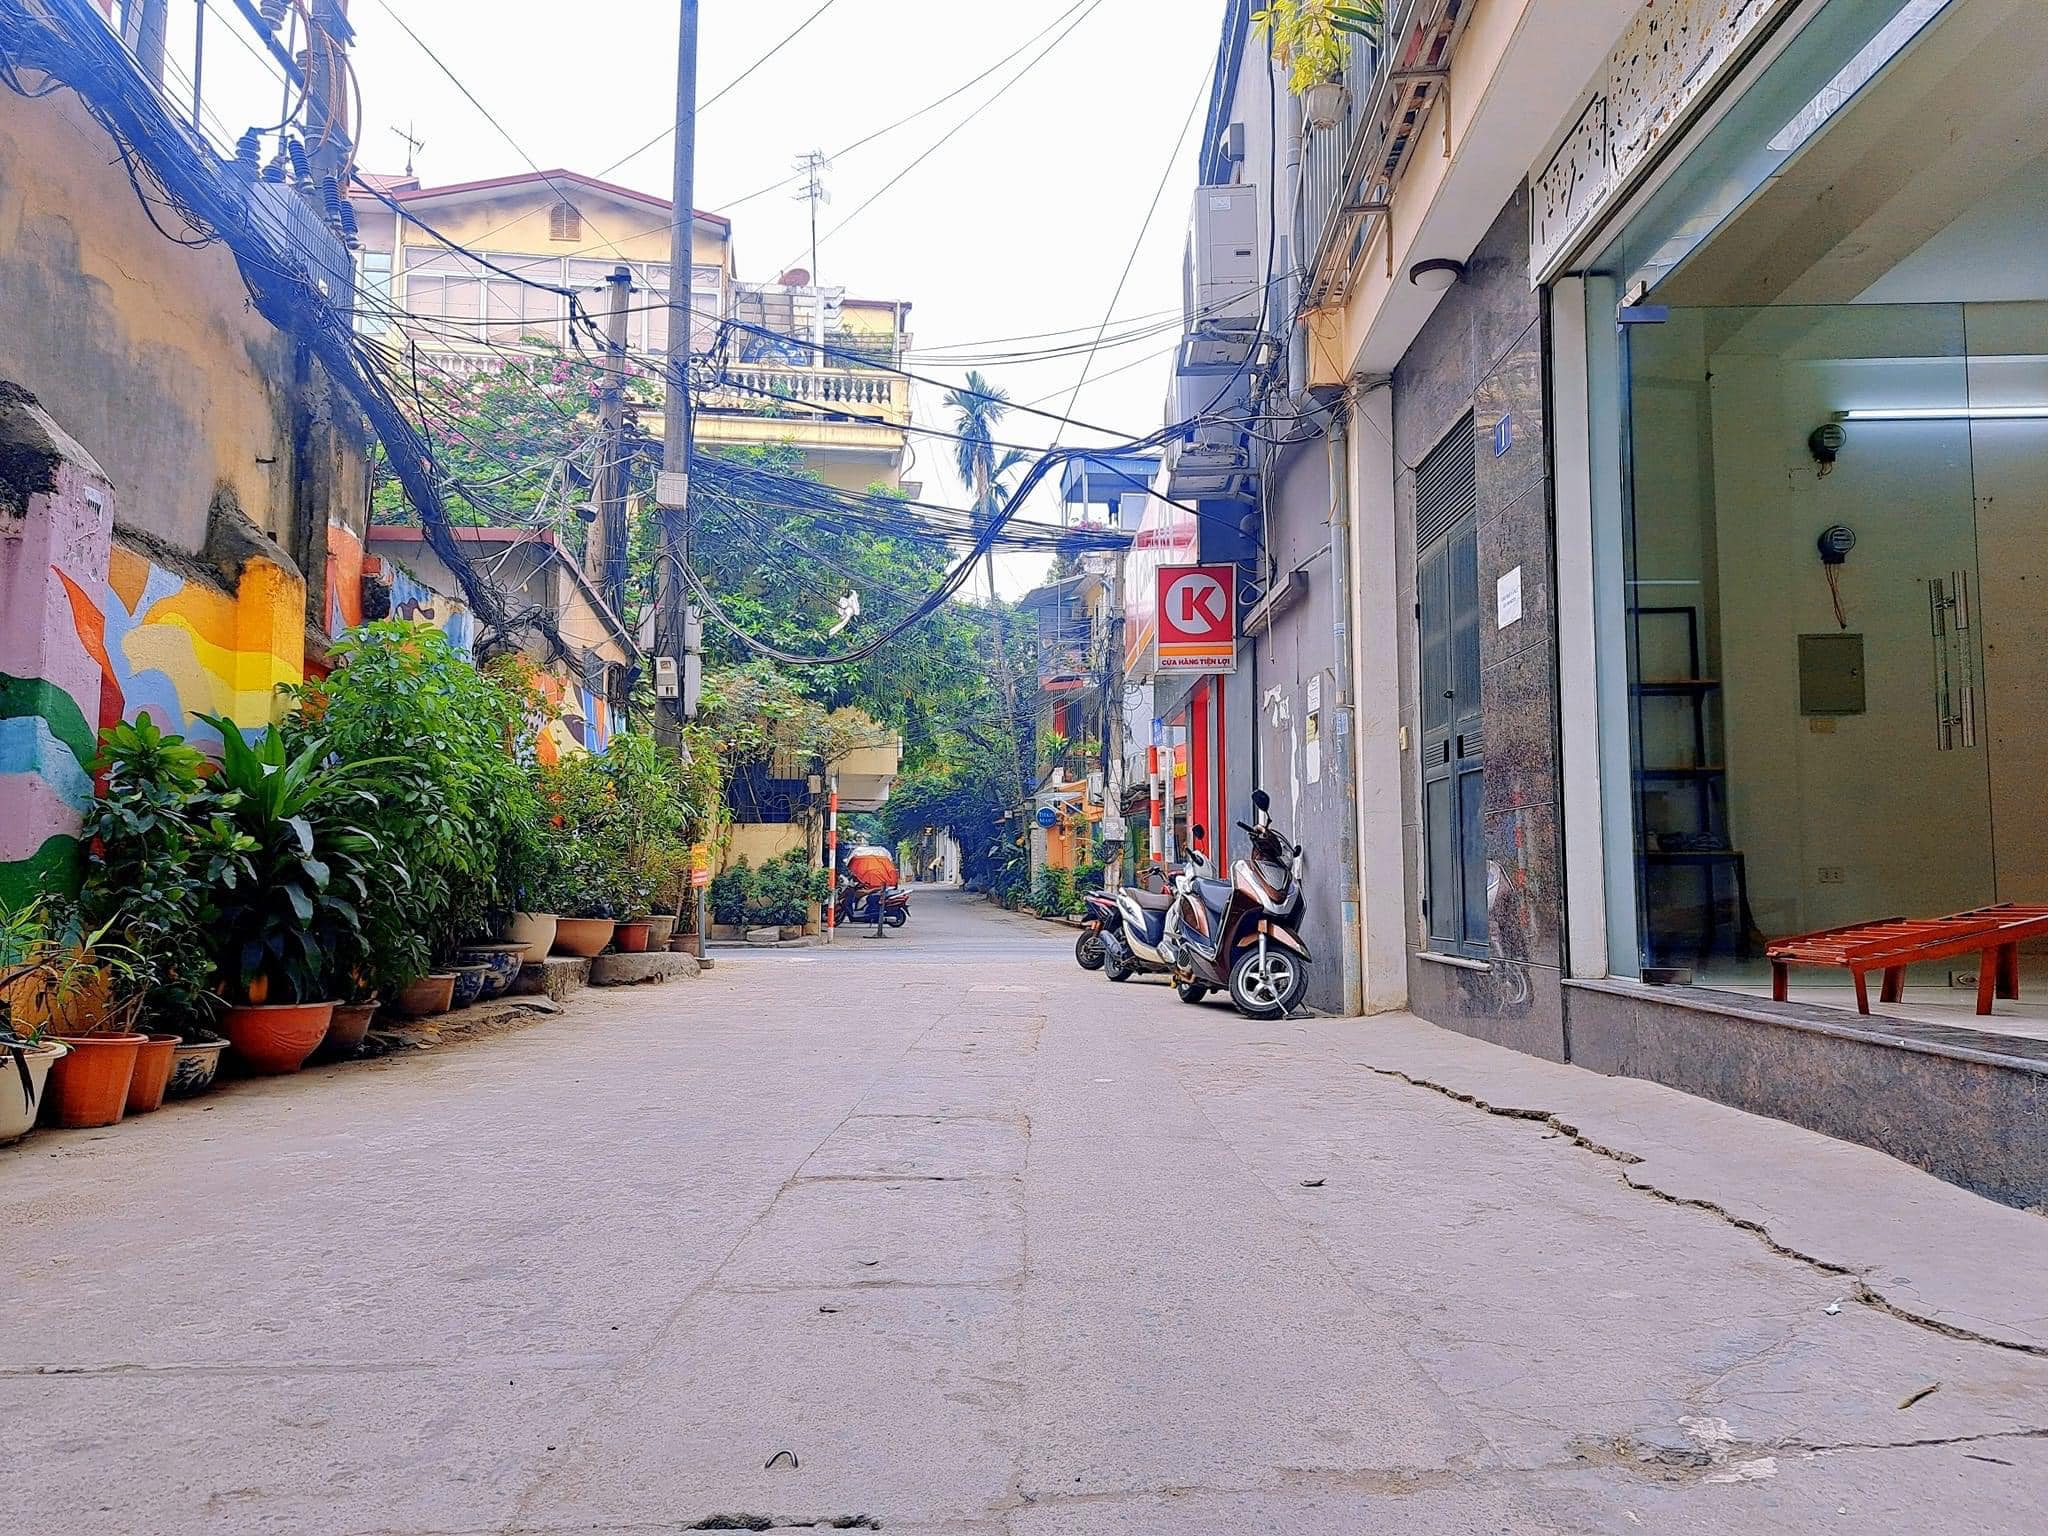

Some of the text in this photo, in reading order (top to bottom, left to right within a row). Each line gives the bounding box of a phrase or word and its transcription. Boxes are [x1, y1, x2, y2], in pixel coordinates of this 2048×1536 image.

[1181, 586, 1222, 631] K
[1178, 657, 1199, 665] HÀNG
[1200, 657, 1217, 666] TIỆN
[1217, 657, 1231, 666] LỢI
